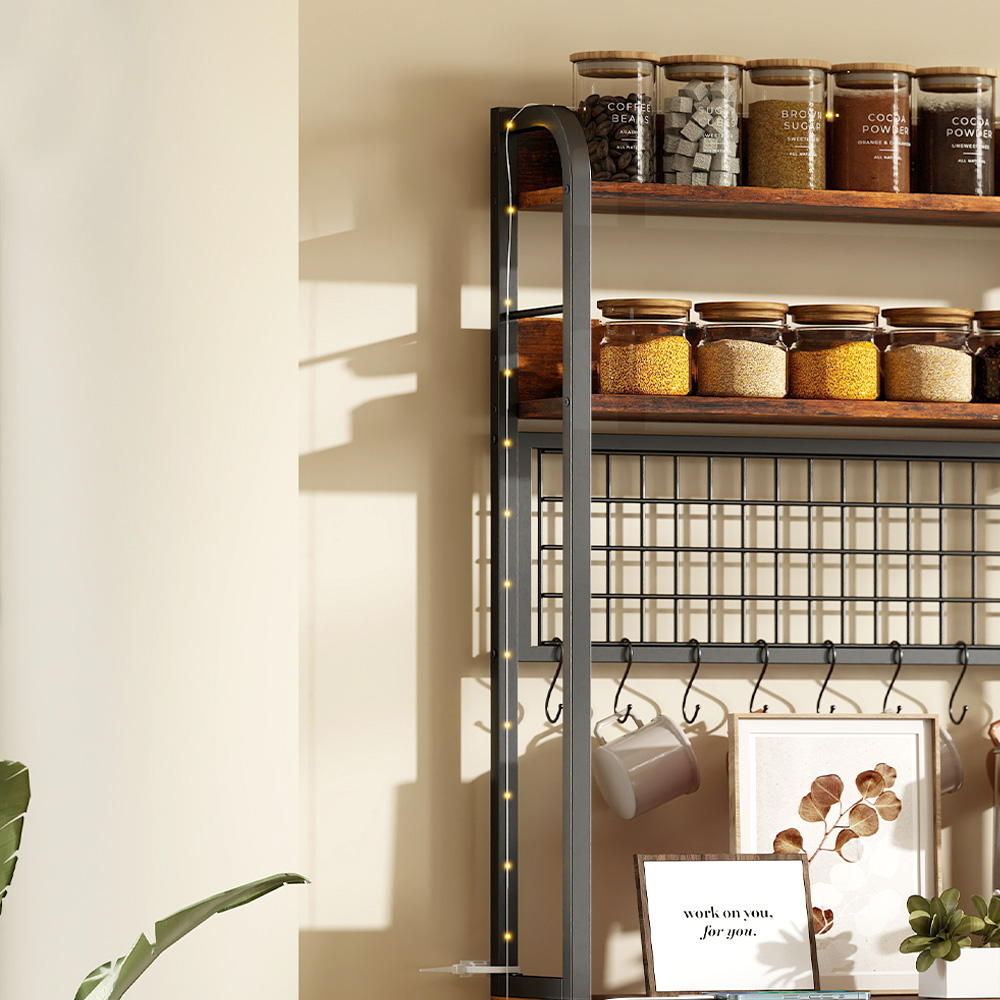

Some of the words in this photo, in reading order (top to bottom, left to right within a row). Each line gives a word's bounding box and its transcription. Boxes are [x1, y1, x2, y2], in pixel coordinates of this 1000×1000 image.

[611, 113, 649, 124] BEAS
[867, 113, 906, 123] COCOA
[951, 116, 990, 127] COCOA
[683, 906, 720, 919] work
[722, 910, 741, 919] on
[743, 910, 773, 922] you,
[699, 925, 724, 940] for
[726, 928, 757, 940] you.
